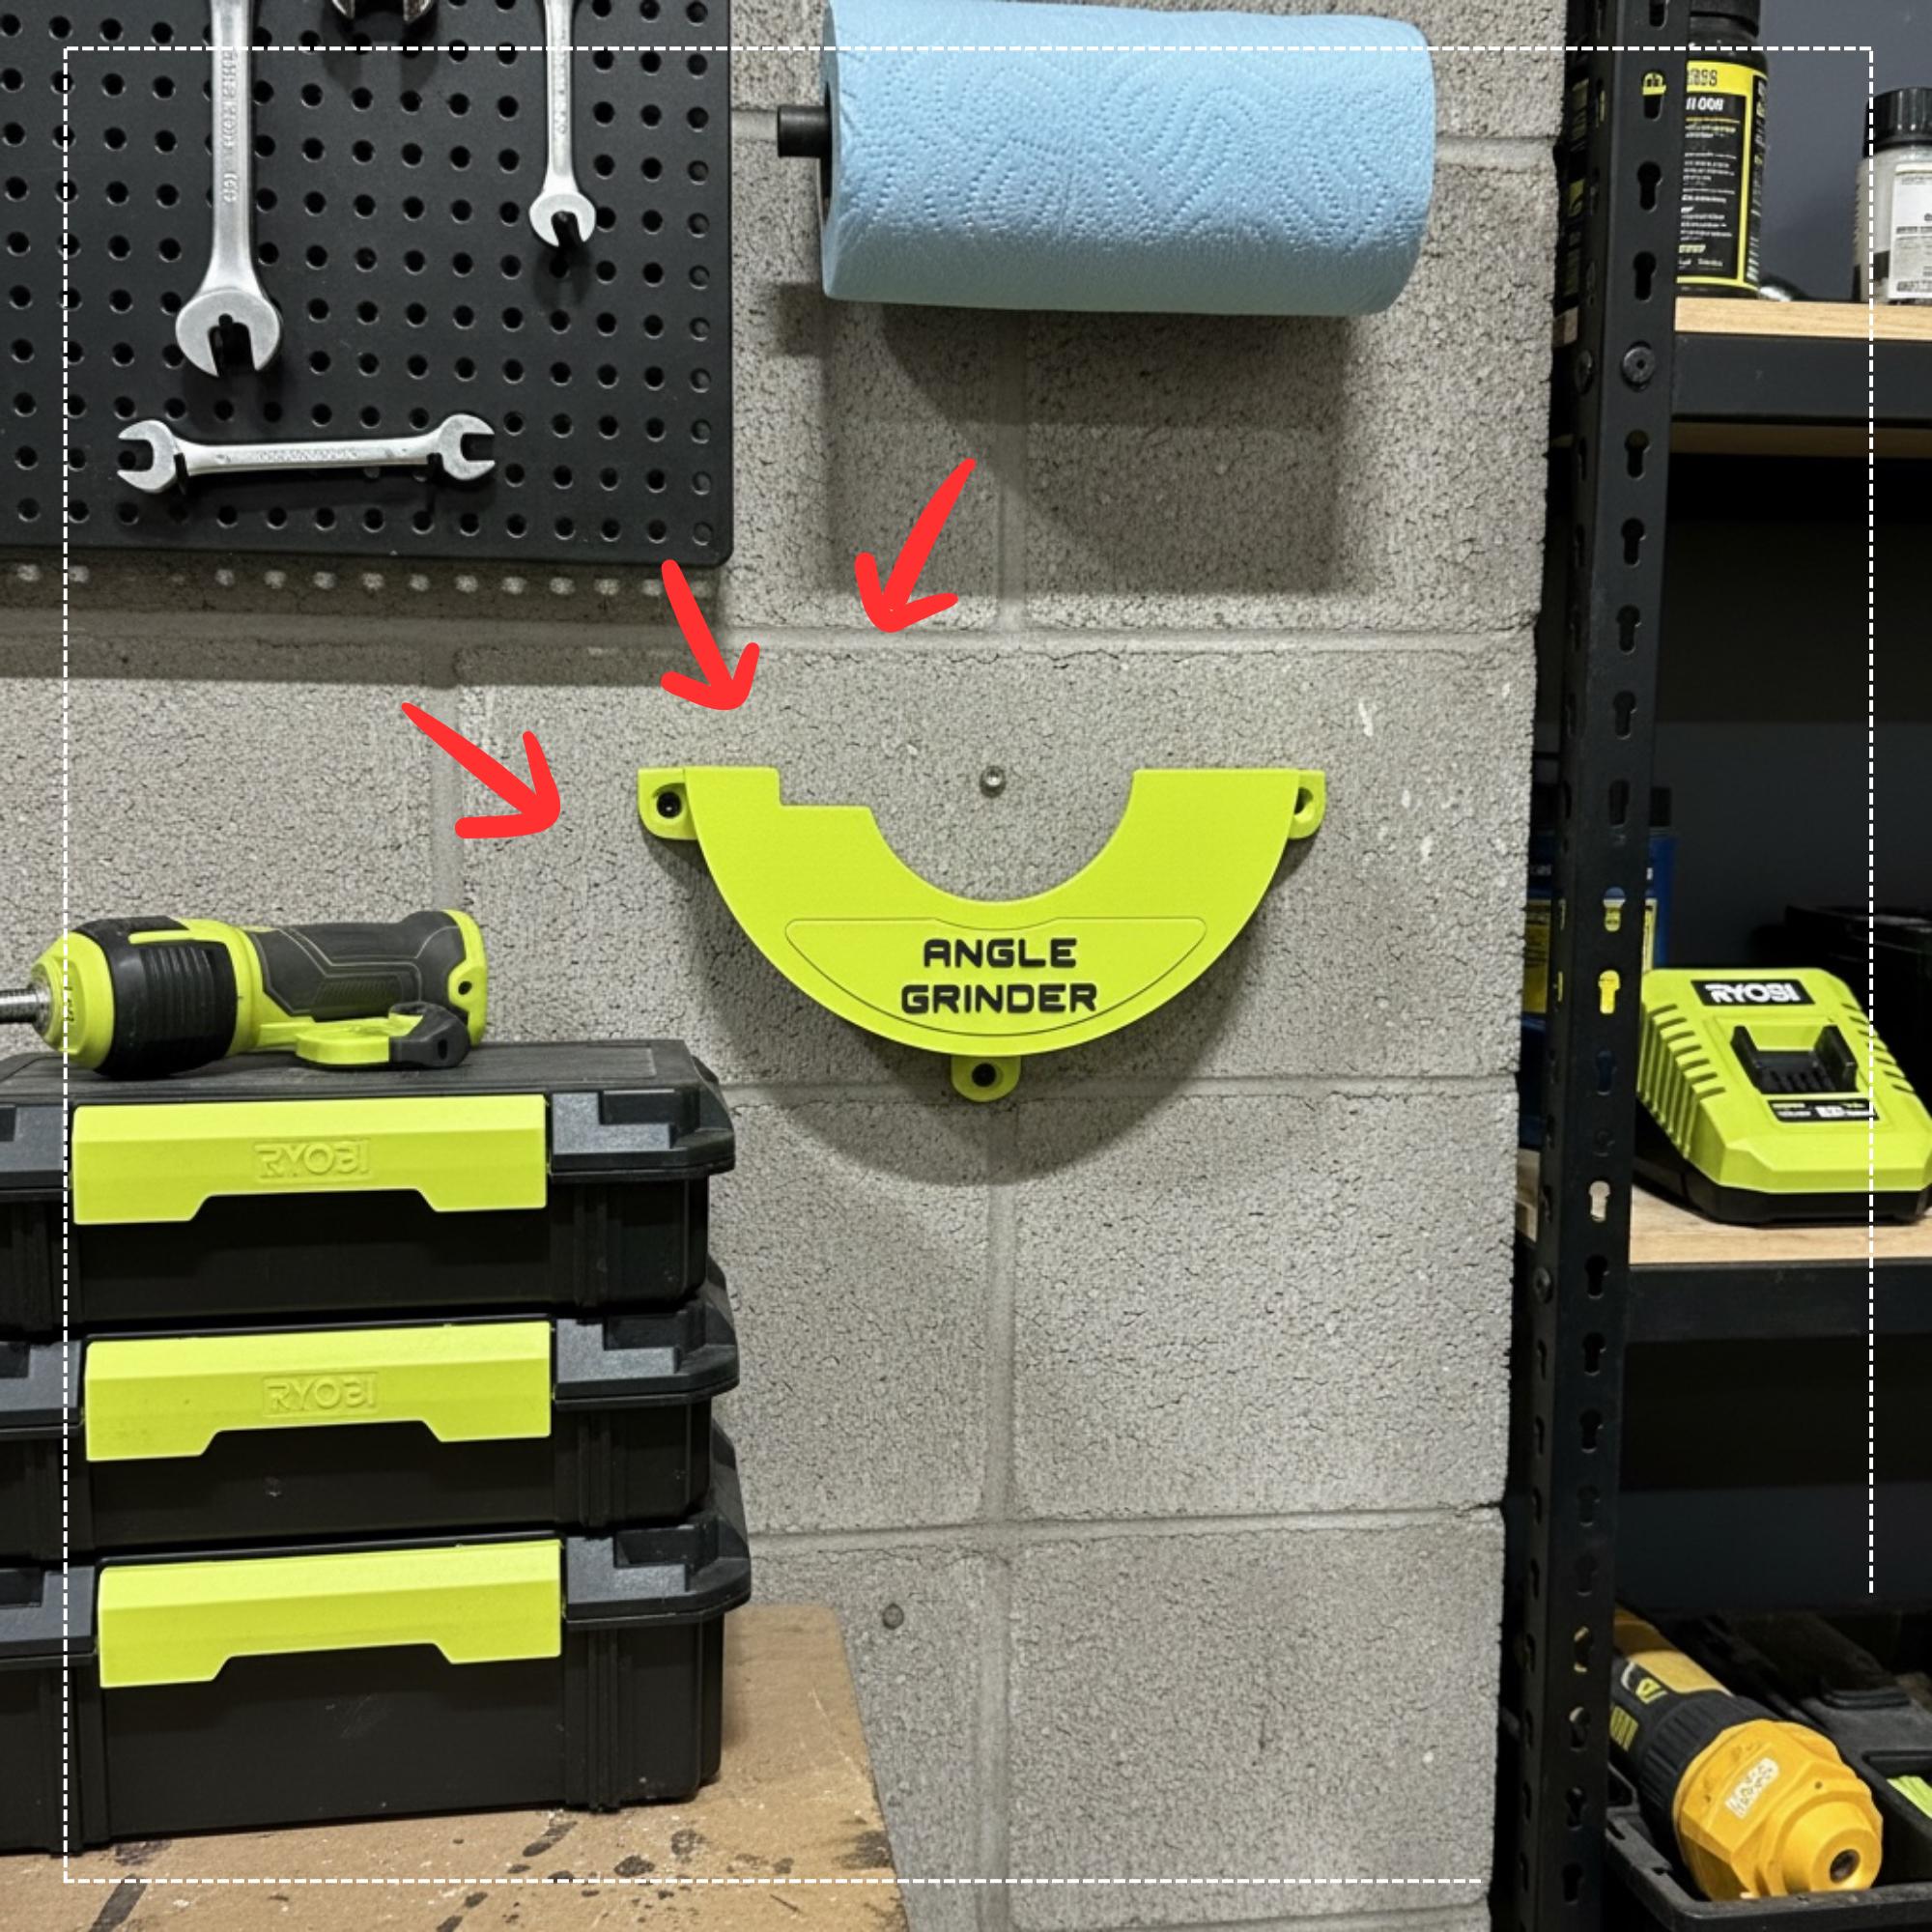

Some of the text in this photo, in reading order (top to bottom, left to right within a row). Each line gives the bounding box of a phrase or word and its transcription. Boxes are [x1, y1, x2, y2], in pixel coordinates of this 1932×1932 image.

[923, 938, 1077, 968] ANGLE
[901, 982, 1097, 1014] GRINDER
[1705, 983, 1802, 1003] RYOBI
[254, 1140, 371, 1178] RYOBI
[264, 1374, 377, 1411] RYOBI
